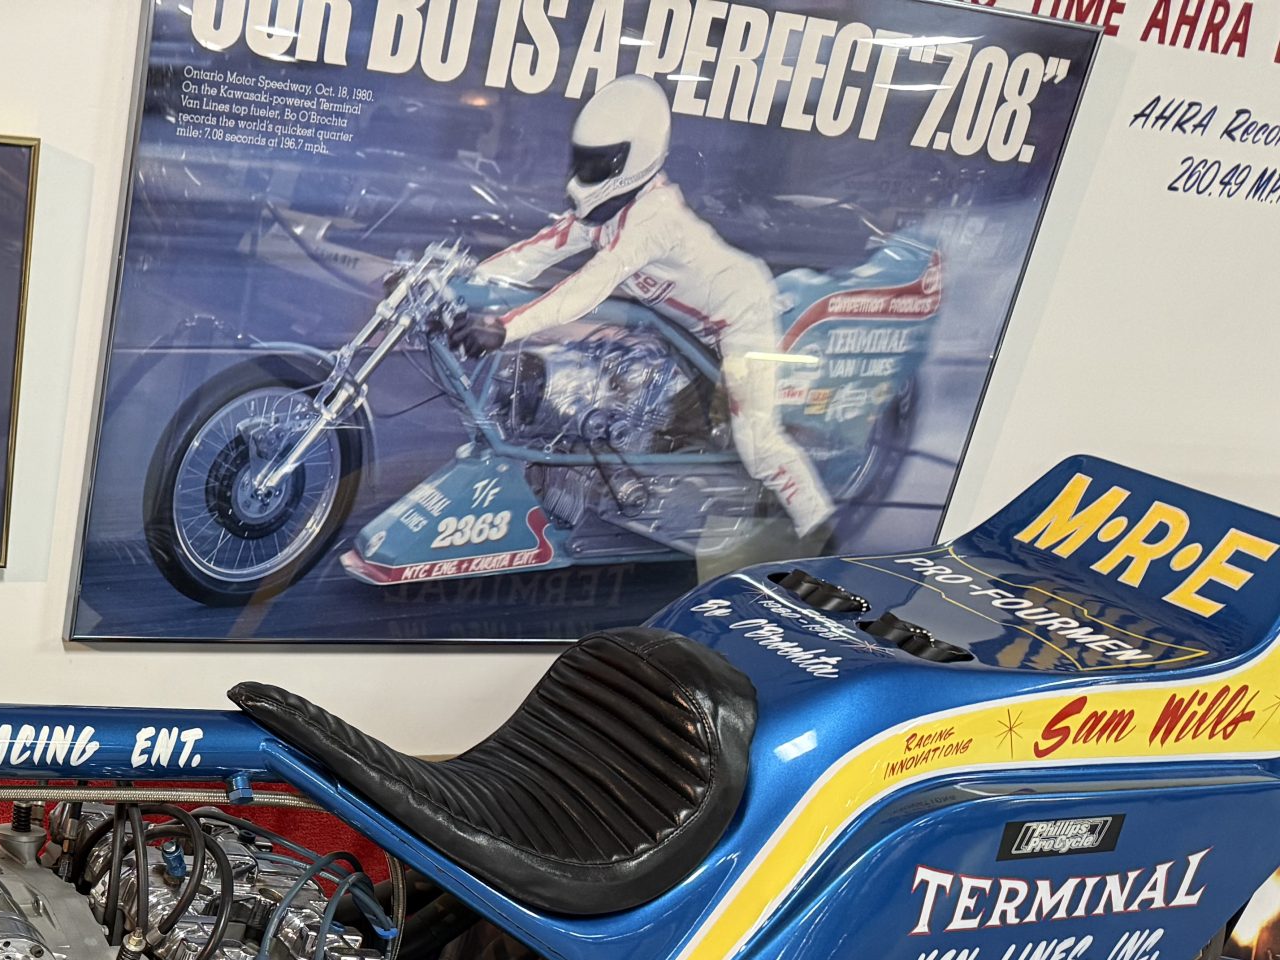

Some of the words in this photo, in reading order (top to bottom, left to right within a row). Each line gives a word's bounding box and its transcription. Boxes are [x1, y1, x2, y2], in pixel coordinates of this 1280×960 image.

[1140, 0, 1254, 58] AHRA
[184, 66, 223, 82] Ontario
[226, 71, 256, 86] Motor
[258, 76, 312, 95] Speedway,
[316, 84, 335, 97] Oct.
[338, 86, 349, 100] 18,
[353, 88, 374, 102] 1980.
[485, 0, 568, 95] IS
[565, 0, 622, 99] A
[637, 0, 913, 141] PERFECT
[181, 95, 199, 108] Van
[203, 98, 229, 112] Lines
[232, 103, 248, 117] top
[250, 104, 280, 119] fueler,
[284, 108, 296, 120] Bo
[299, 111, 347, 127] O'Brochta
[182, 81, 198, 93] On
[201, 83, 217, 96] the
[220, 86, 316, 109] Kawasaki-powered
[319, 98, 361, 114] Terminal
[178, 112, 216, 125] records
[219, 116, 235, 128] the
[238, 118, 272, 131] world's
[275, 123, 315, 138] quickest
[317, 128, 353, 142] quarter
[1129, 95, 1218, 136] AHRA
[1220, 108, 1280, 146] Reco
[176, 126, 202, 138] mile:
[204, 128, 222, 140] 7.08
[225, 132, 265, 146] seconds
[268, 137, 278, 147] at
[280, 137, 303, 150] 196.7
[305, 141, 328, 154] mph.
[1167, 156, 1252, 198] 260.49
[826, 329, 910, 354] TERMINAL
[828, 358, 855, 378] VAN
[860, 358, 896, 376] LINES
[472, 478, 502, 508] T/F
[430, 510, 512, 548] 2363
[401, 566, 427, 580] MTC
[431, 562, 456, 576] ENG.
[894, 557, 1154, 661] PRO-FOURMEN
[904, 725, 955, 753] RACING
[1032, 695, 1138, 759] Sam
[1146, 684, 1255, 748] Wills
[130, 726, 204, 768] ENT.
[884, 738, 974, 780] INNOVATIONS
[1034, 820, 1090, 837] Phillips
[907, 846, 1214, 936] TERMINAL
